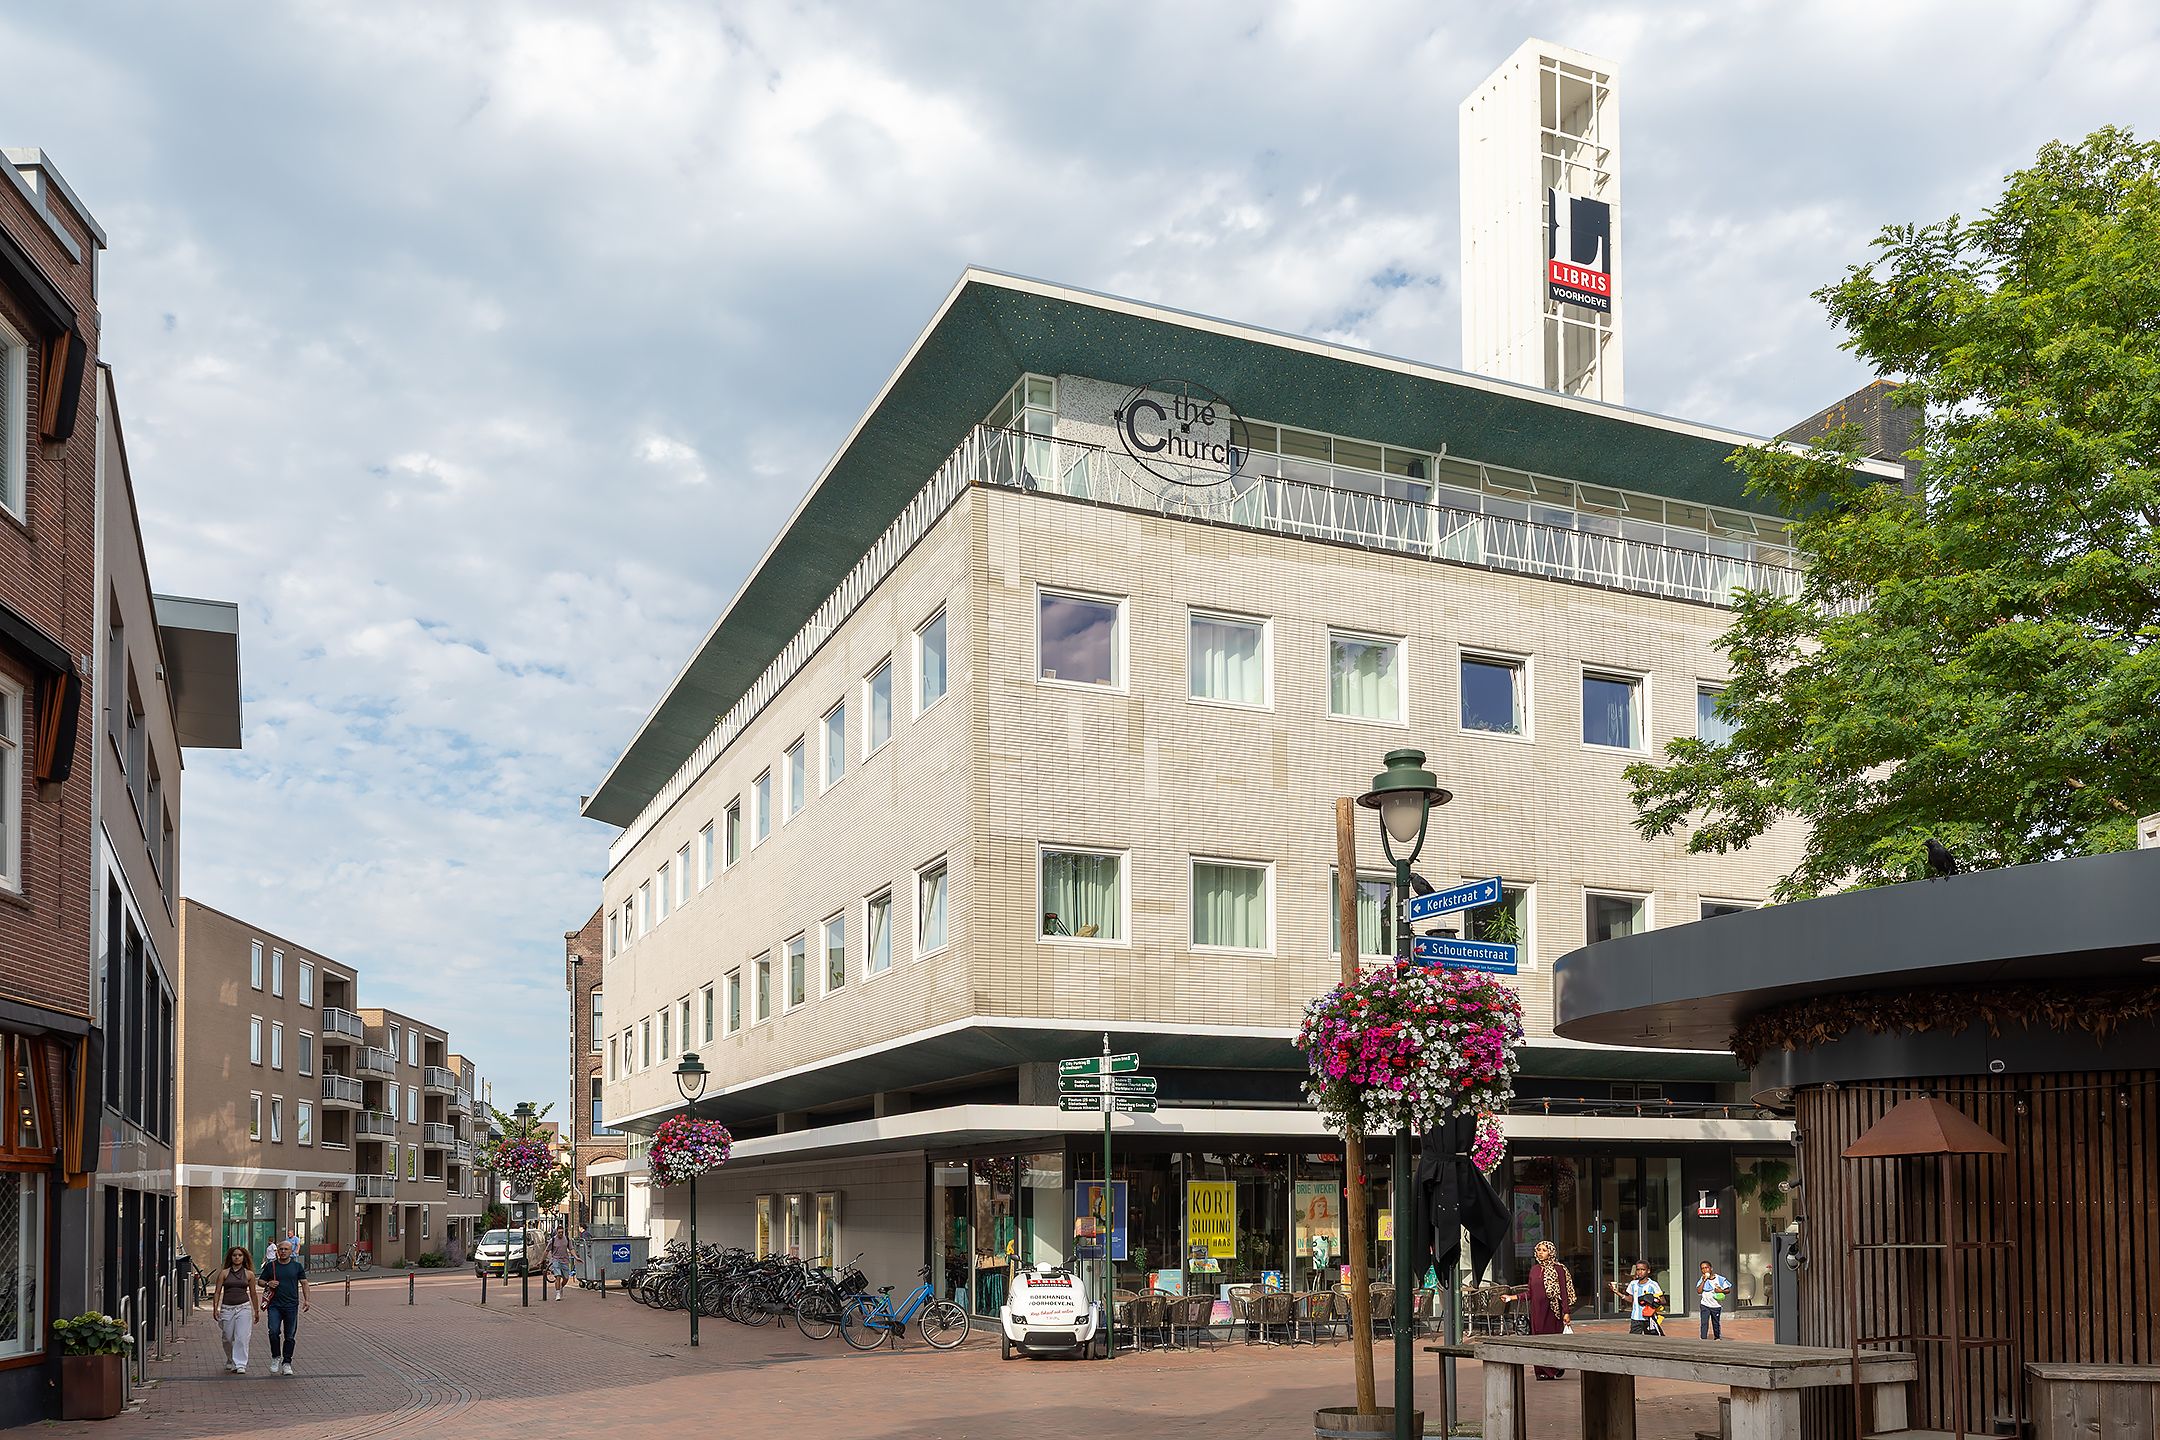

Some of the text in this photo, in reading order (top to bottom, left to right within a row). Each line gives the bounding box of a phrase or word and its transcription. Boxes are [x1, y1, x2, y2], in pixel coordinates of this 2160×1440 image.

[1553, 264, 1607, 291] LIBRIS
[1552, 287, 1608, 308] VOORHOEVE
[1173, 395, 1216, 426] the
[1126, 399, 1241, 467] Church
[1427, 890, 1477, 911] Kerkstraat
[1432, 943, 1508, 961] Schoutenstraat
[1296, 1183, 1337, 1195] DRIE WEKEN
[1192, 1189, 1232, 1214] KORT
[1192, 1219, 1231, 1234] SLUITING
[1212, 1238, 1231, 1247] HAAS
